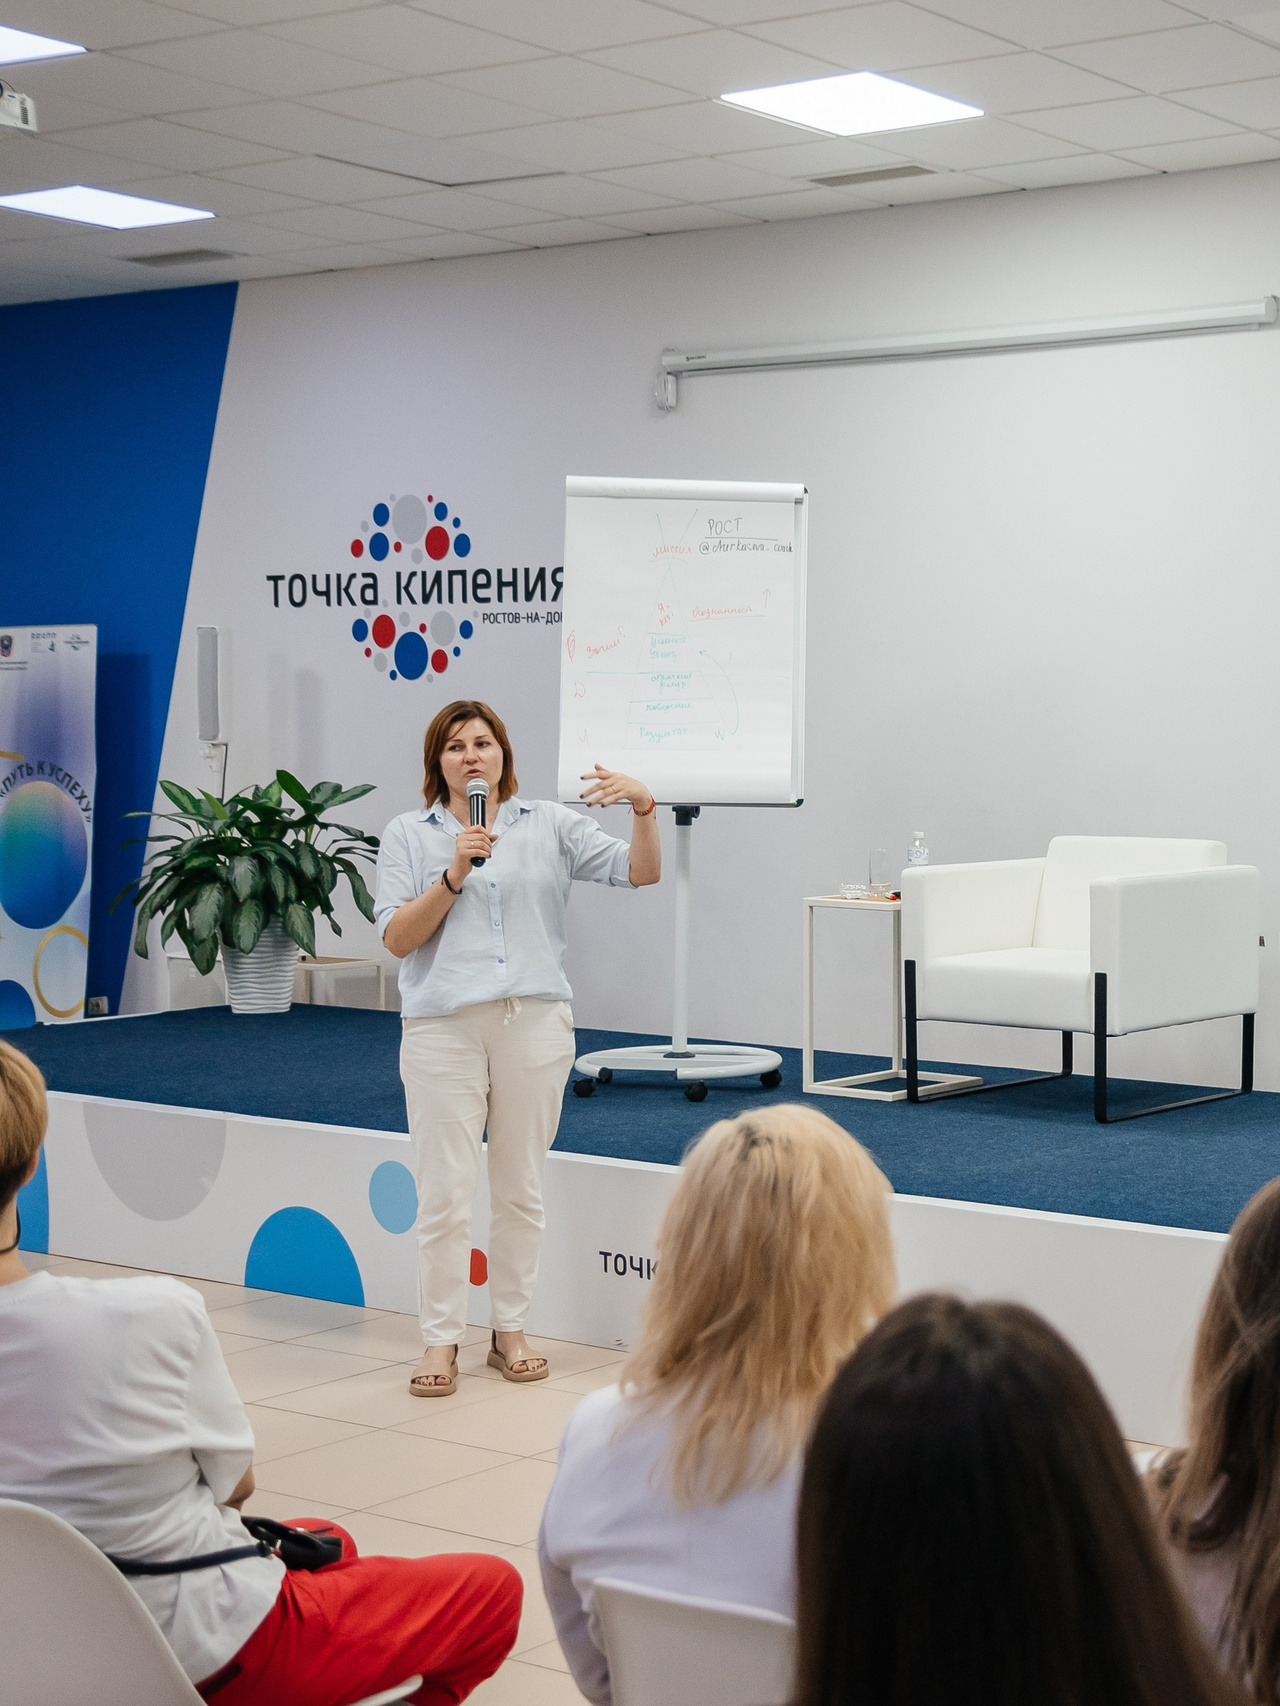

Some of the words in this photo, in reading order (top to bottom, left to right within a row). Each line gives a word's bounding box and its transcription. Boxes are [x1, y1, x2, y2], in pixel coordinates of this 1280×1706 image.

[708, 517, 743, 536] РОСТ
[266, 572, 379, 608] точка
[482, 611, 562, 626] РОСТОВ-НА-ДО
[37, 761, 45, 775] К
[598, 1250, 658, 1281] точк
